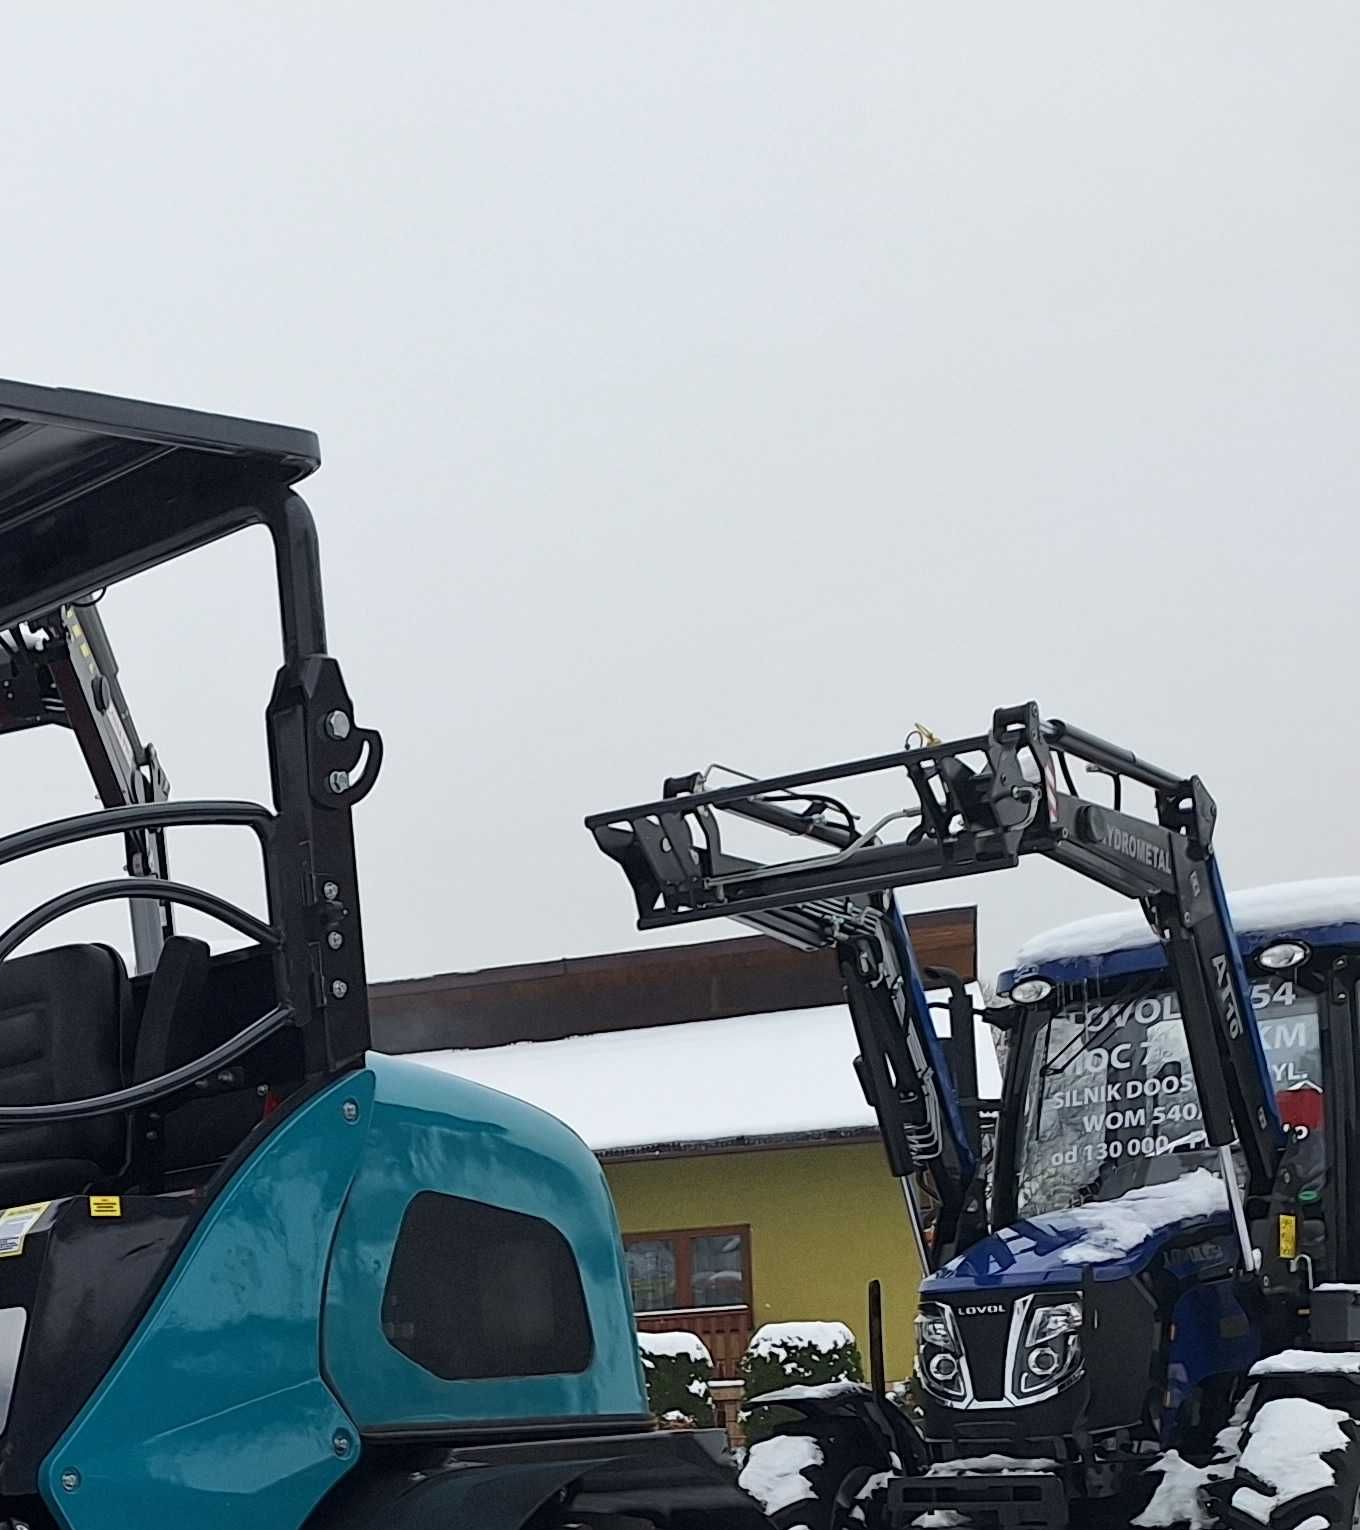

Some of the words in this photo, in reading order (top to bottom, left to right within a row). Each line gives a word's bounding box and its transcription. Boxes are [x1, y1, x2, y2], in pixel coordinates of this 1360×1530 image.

[1103, 823, 1172, 875] YDROMETAL
[1052, 1081, 1122, 1109] SILNIK
[1125, 1073, 1194, 1099] DOOS
[1082, 1108, 1146, 1133] WOM
[1051, 1144, 1078, 1166] od
[1084, 1140, 1122, 1161] 130
[957, 1304, 1007, 1317] LOVOL
